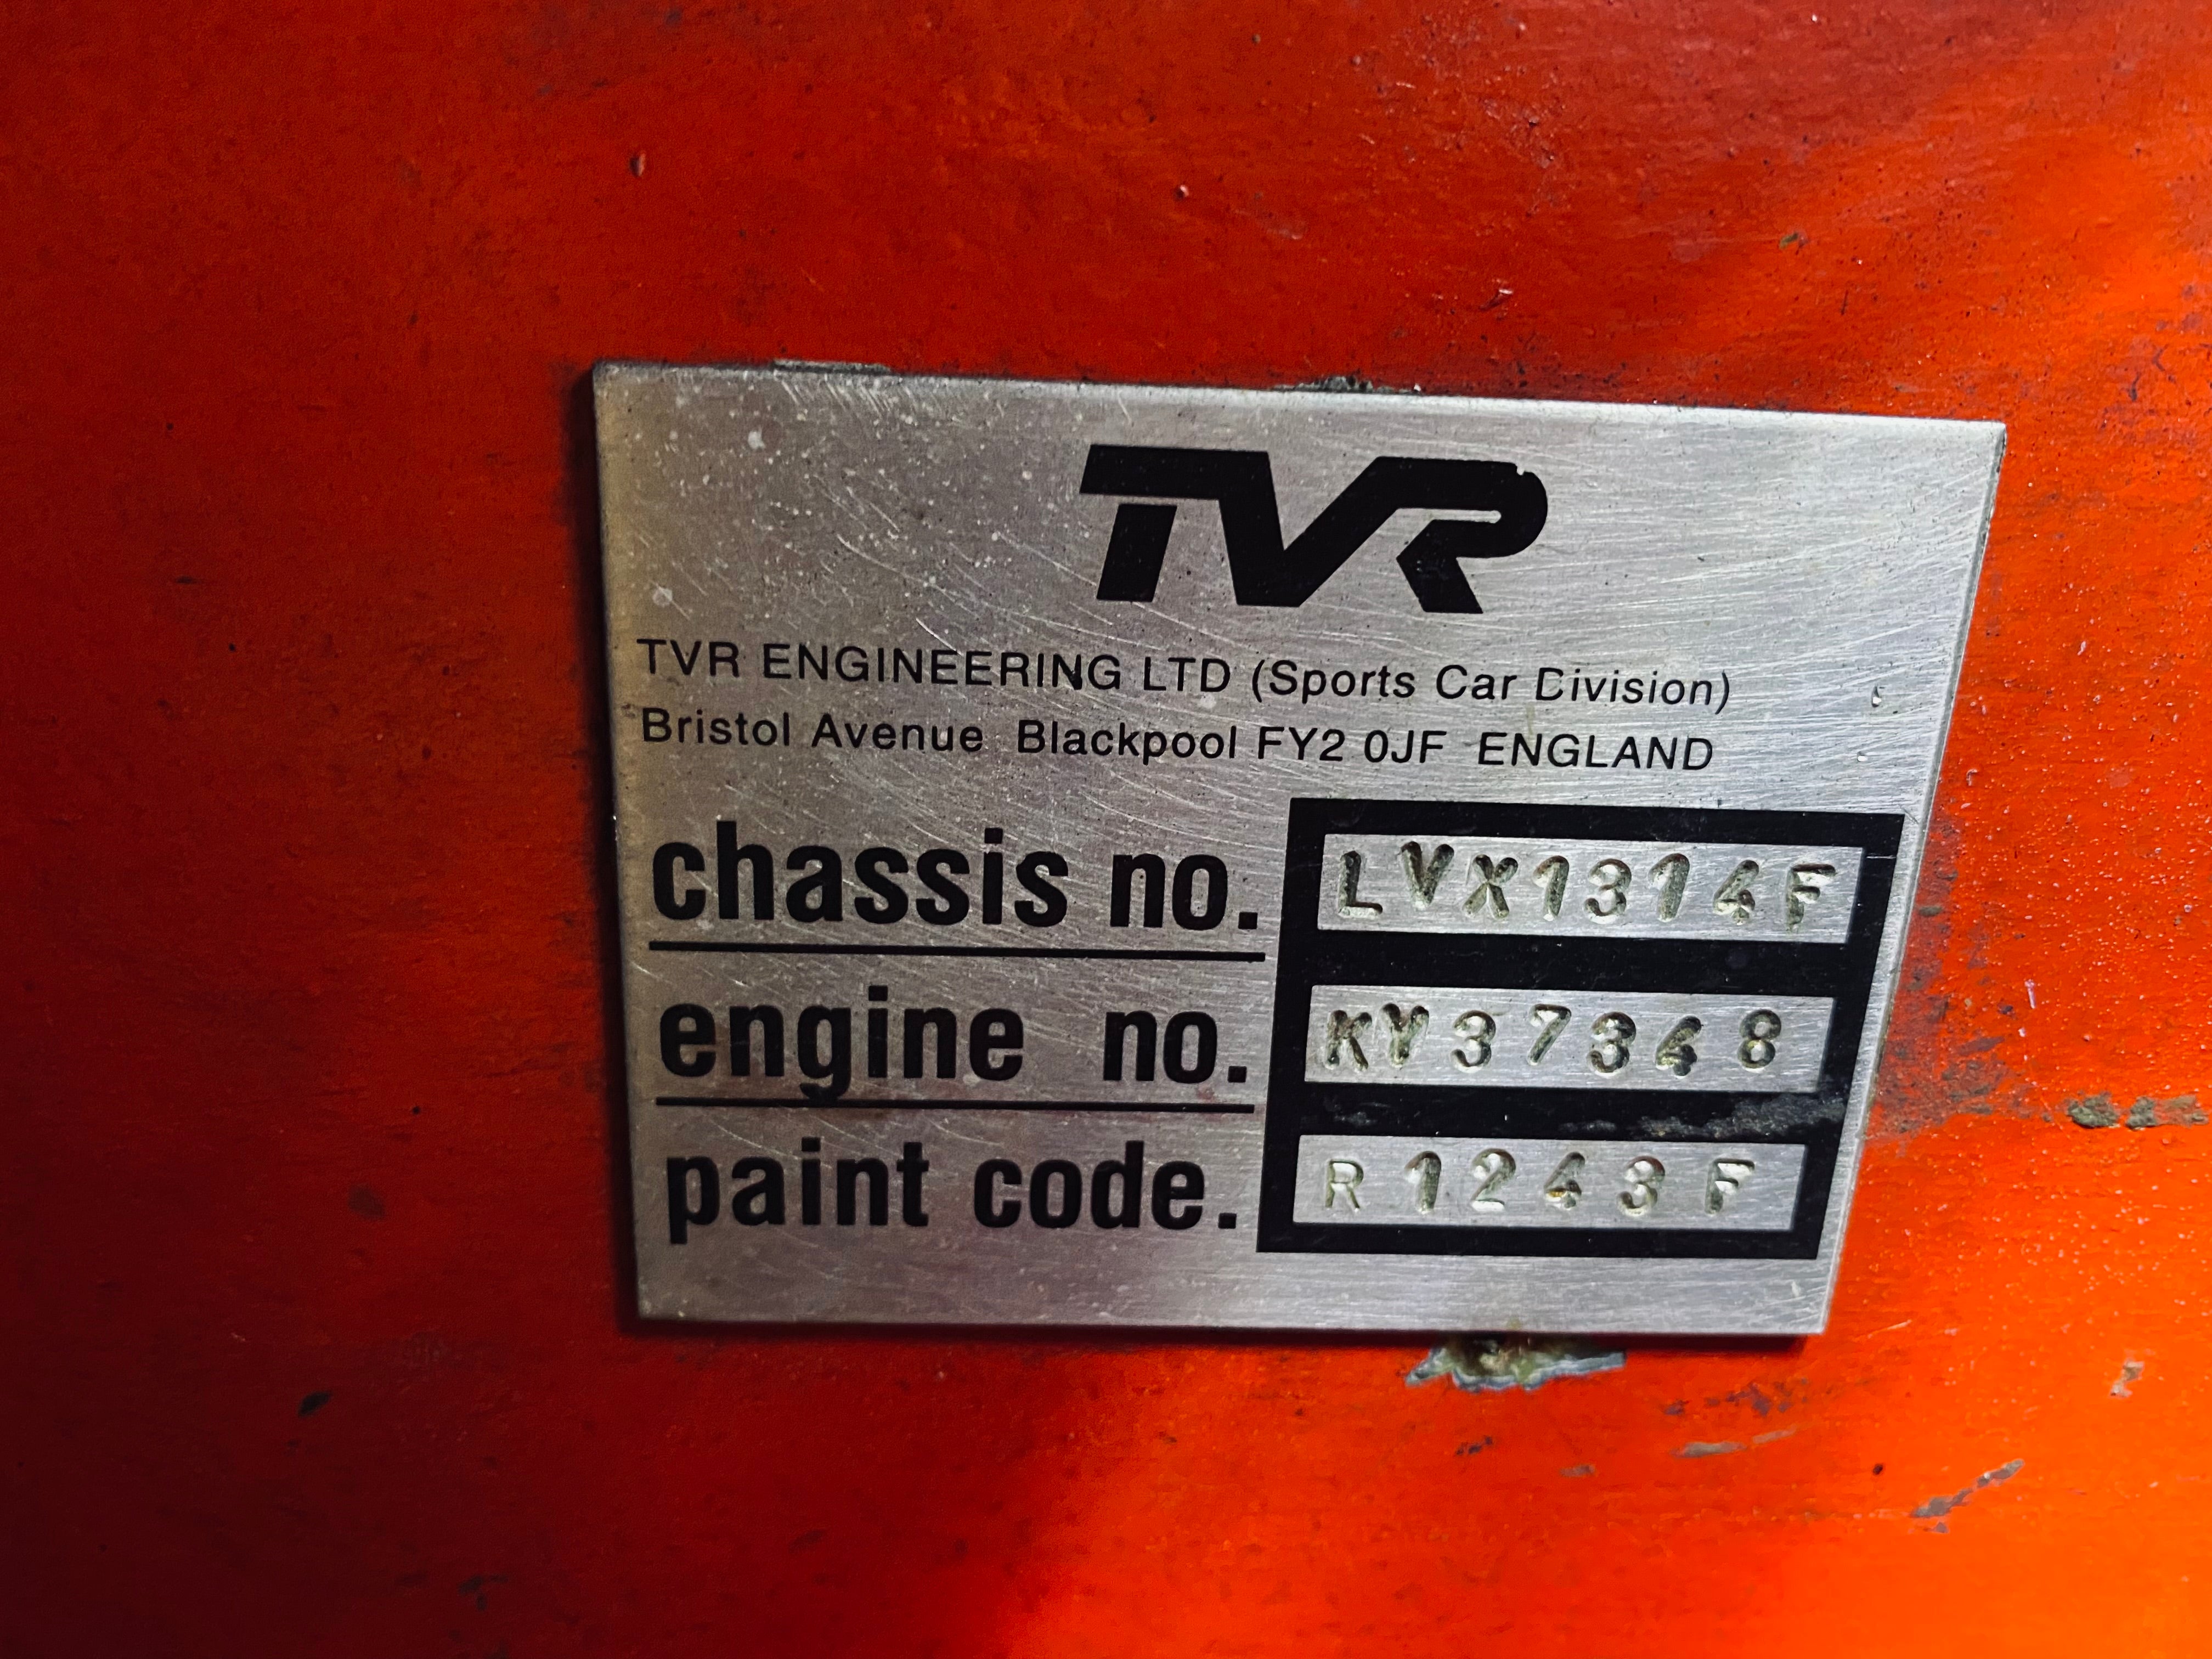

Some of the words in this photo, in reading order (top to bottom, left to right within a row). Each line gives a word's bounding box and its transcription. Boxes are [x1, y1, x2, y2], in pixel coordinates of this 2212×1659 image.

[1079, 443, 1549, 614] TVR
[636, 639, 740, 678] TVR
[763, 642, 1121, 690] ENGINEERING
[1143, 657, 1231, 693] LTD
[1252, 660, 1416, 704] (Sports
[1436, 664, 1517, 701] Car
[1536, 668, 1731, 714] Division)
[642, 708, 790, 746] Bristol
[811, 714, 984, 752] Avenue
[1017, 720, 1237, 765] Blackpool
[1257, 726, 1345, 762] FY2
[1477, 732, 1714, 771] ENGLAND
[652, 821, 1069, 925] chassis
[1110, 852, 1259, 930] no.
[1337, 840, 1838, 933] LVX1314F
[659, 985, 1024, 1098] engine
[1104, 1011, 1248, 1084] no.
[1323, 1002, 1783, 1079] KY37348
[666, 1137, 929, 1245] paint
[974, 1141, 1237, 1229] code.
